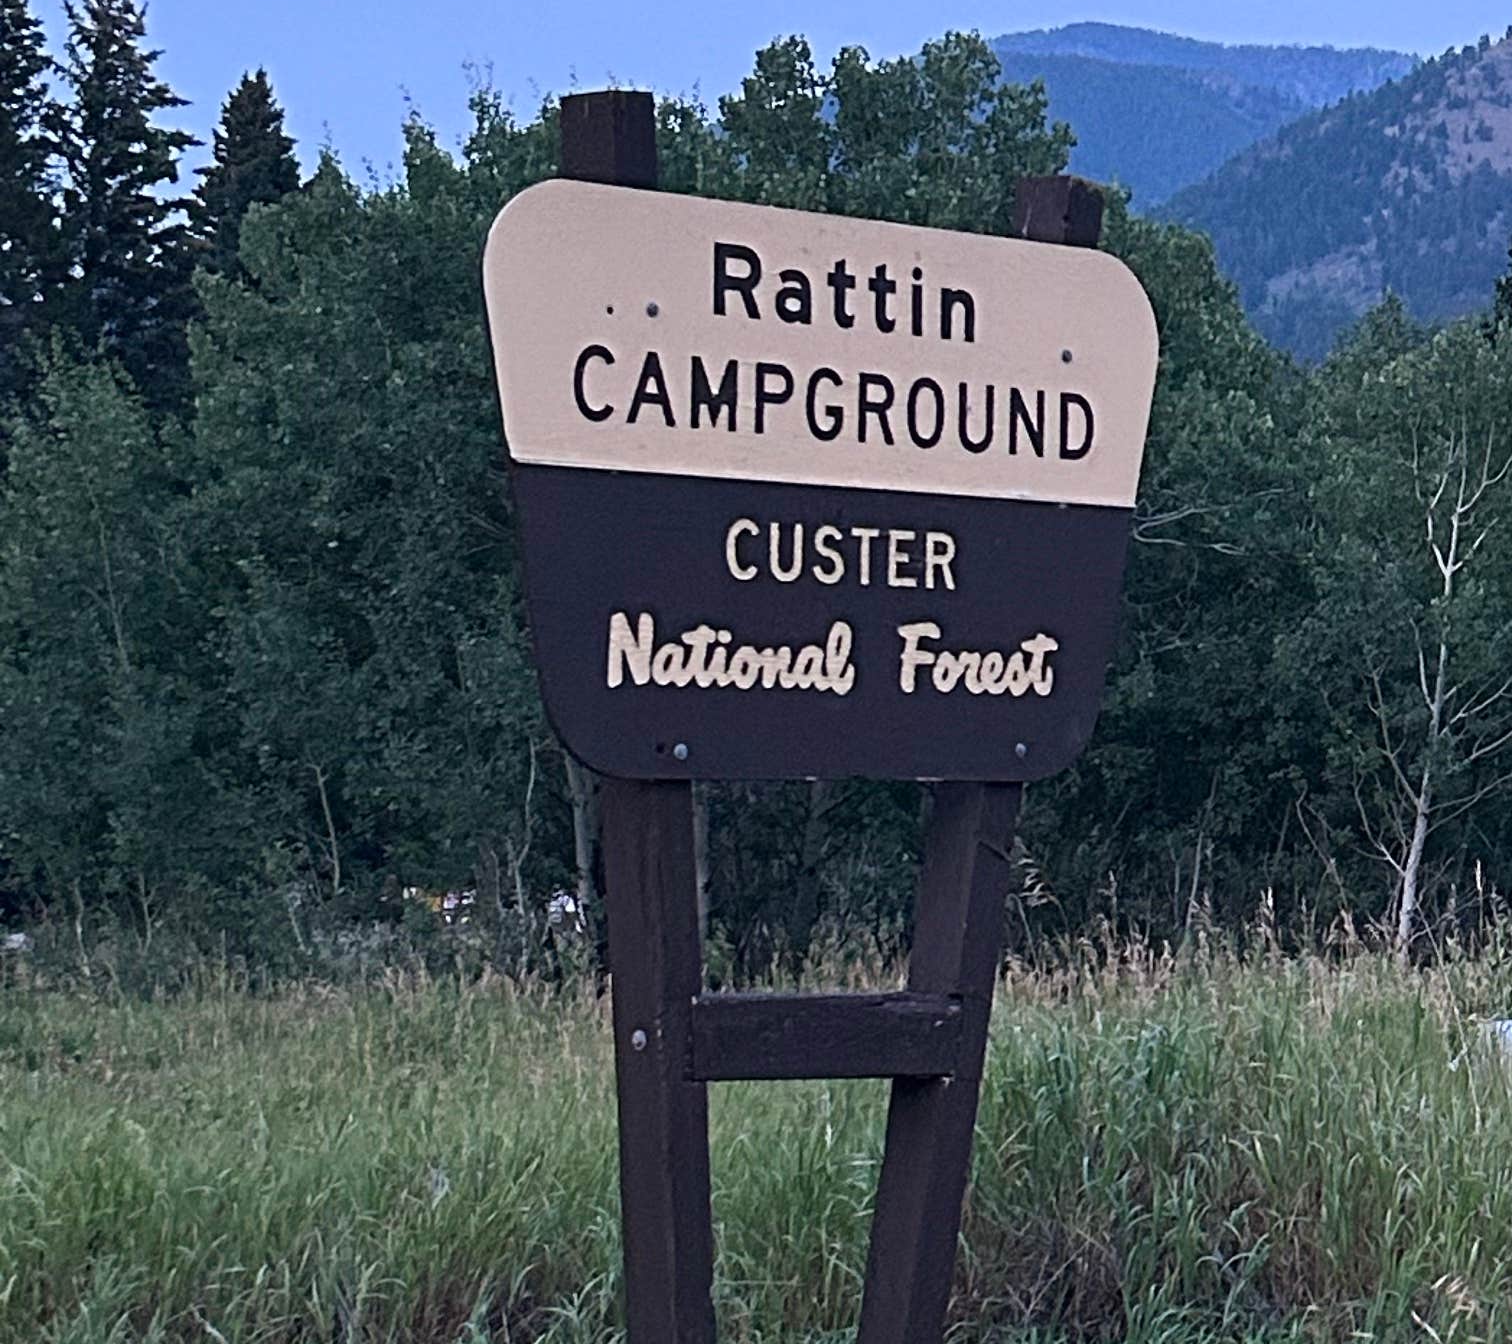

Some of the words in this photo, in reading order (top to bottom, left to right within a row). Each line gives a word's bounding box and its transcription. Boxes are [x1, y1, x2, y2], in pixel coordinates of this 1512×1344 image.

[712, 241, 976, 343] Rattin
[573, 344, 1095, 460] CAMPGROUND
[725, 517, 956, 590] CUSTER
[607, 611, 855, 695] National
[897, 621, 1058, 696] Forest
